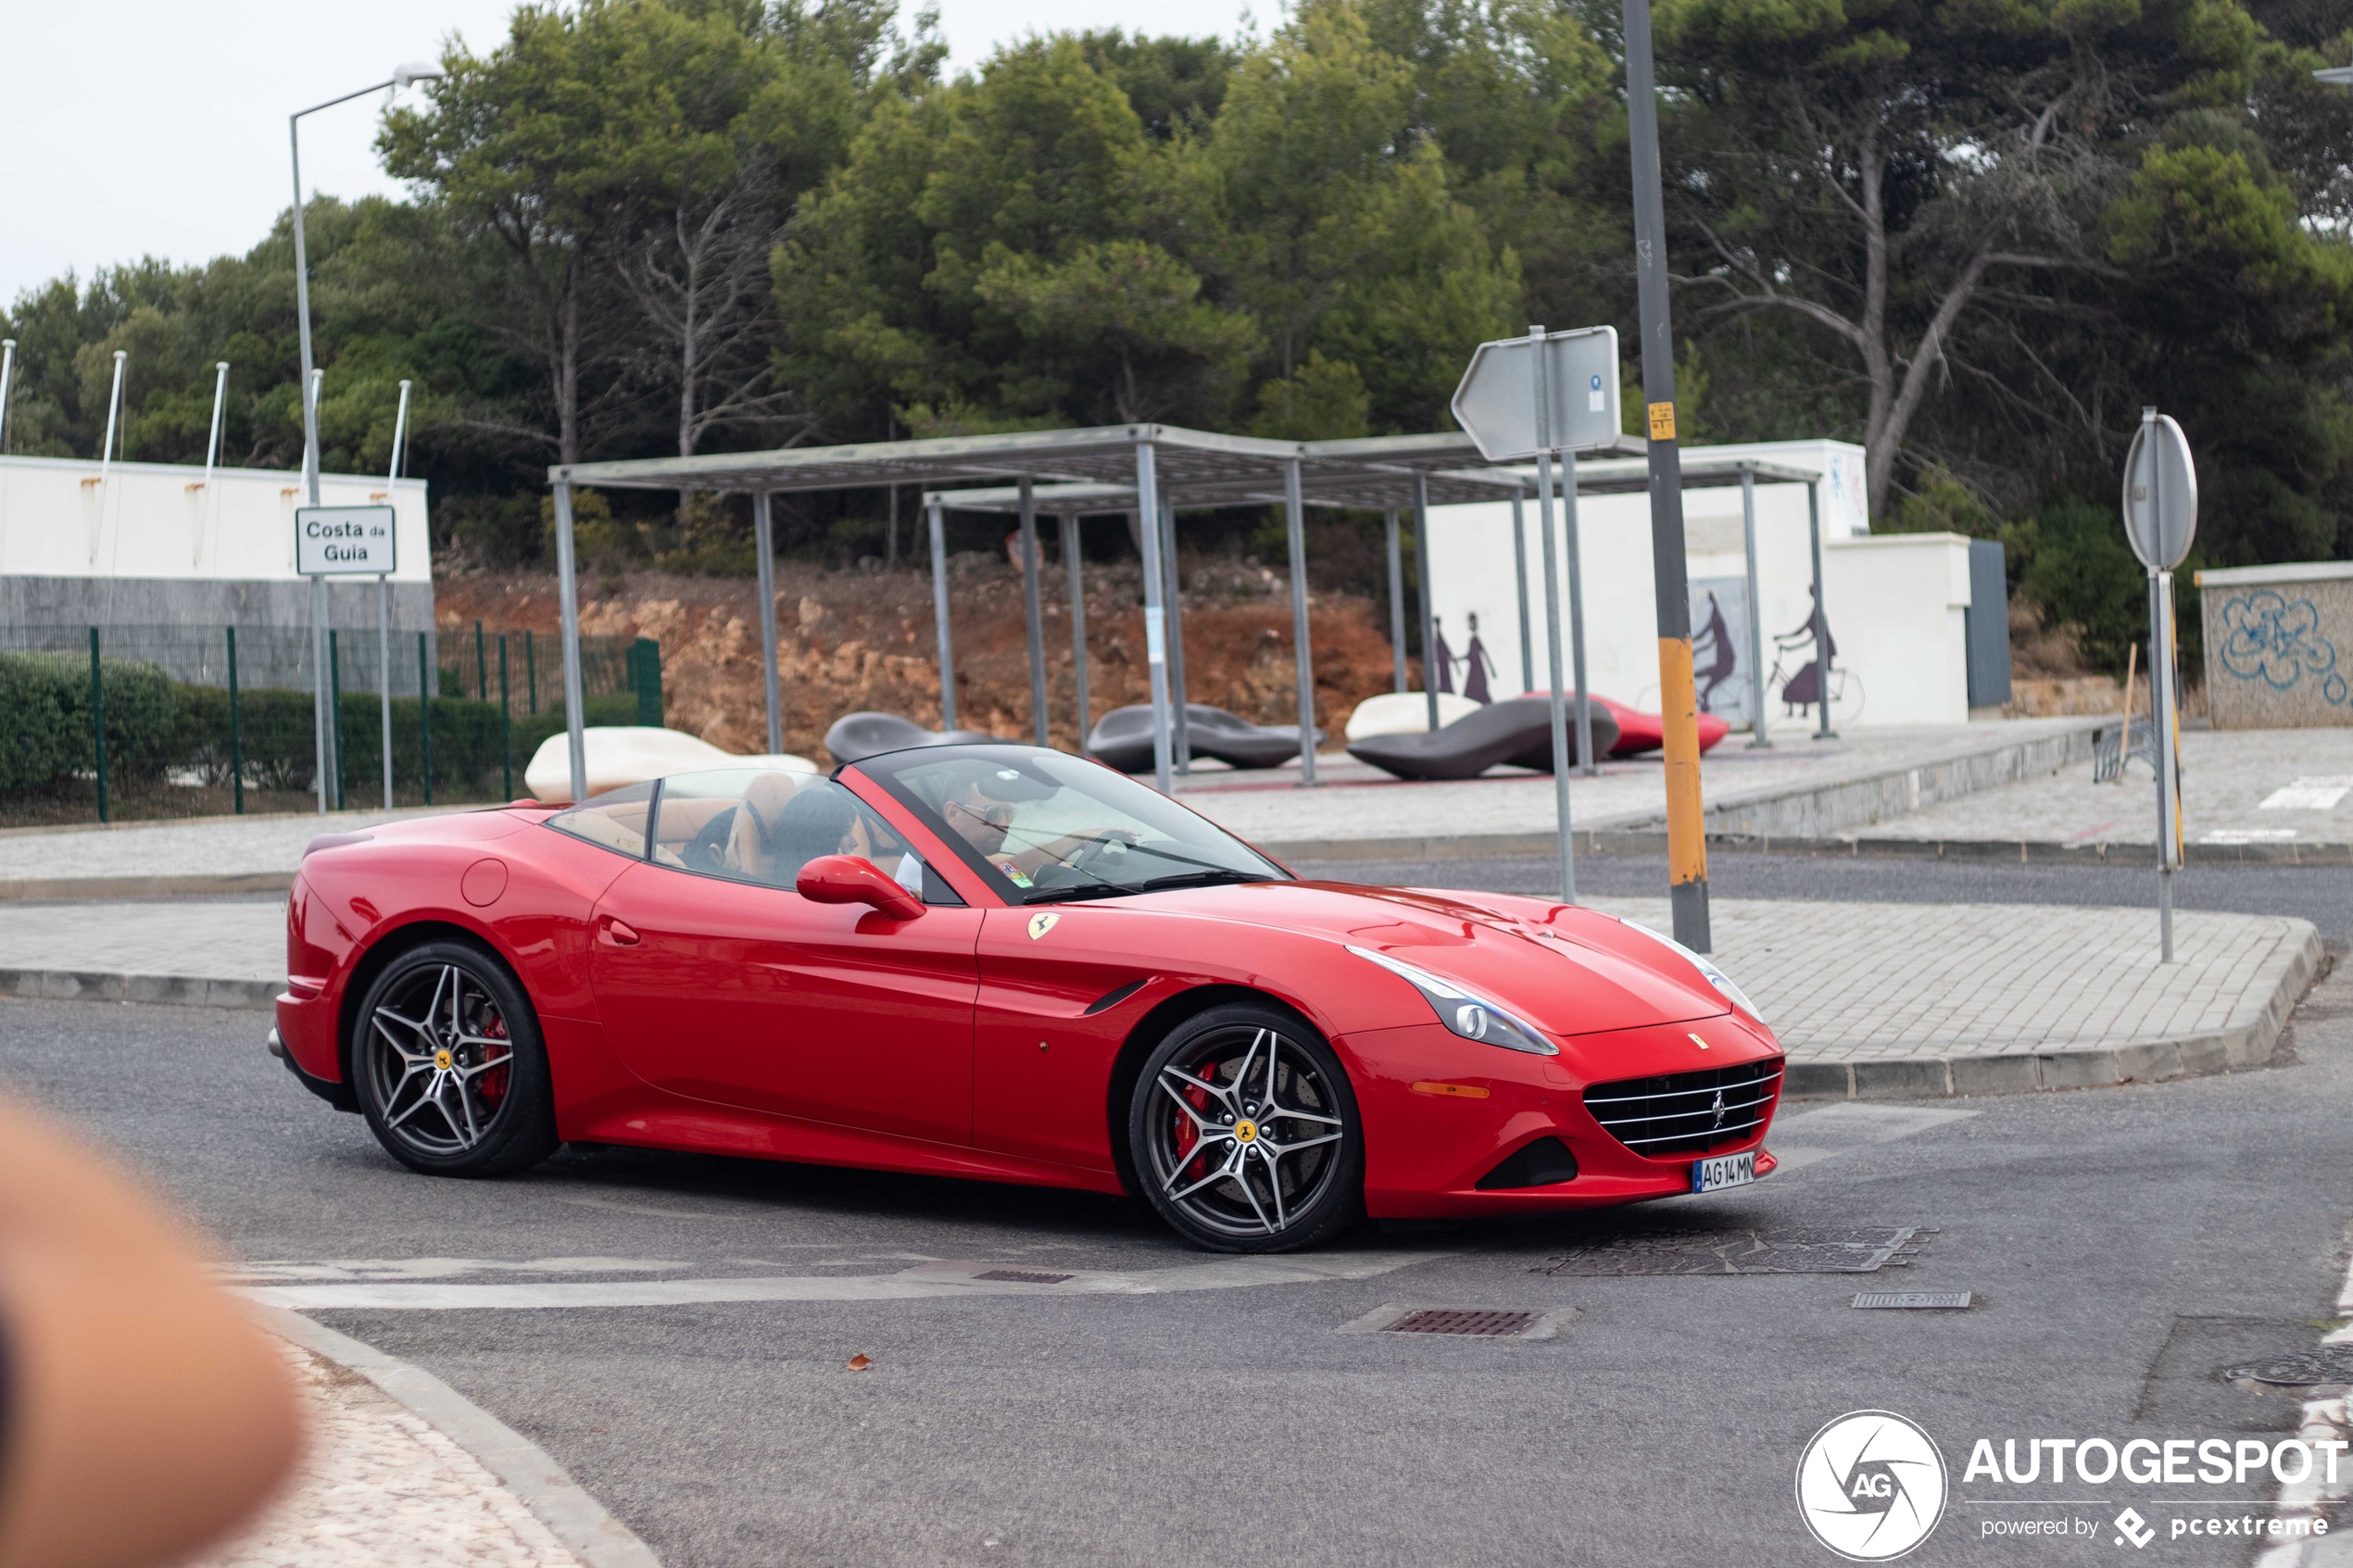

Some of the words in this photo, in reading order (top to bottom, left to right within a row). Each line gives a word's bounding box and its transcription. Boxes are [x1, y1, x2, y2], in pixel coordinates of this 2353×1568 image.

[307, 521, 363, 538] Costa
[370, 525, 385, 537] da
[1703, 1161, 1722, 1187] AG
[1724, 1159, 1735, 1185] 14
[1737, 1155, 1755, 1181] MN
